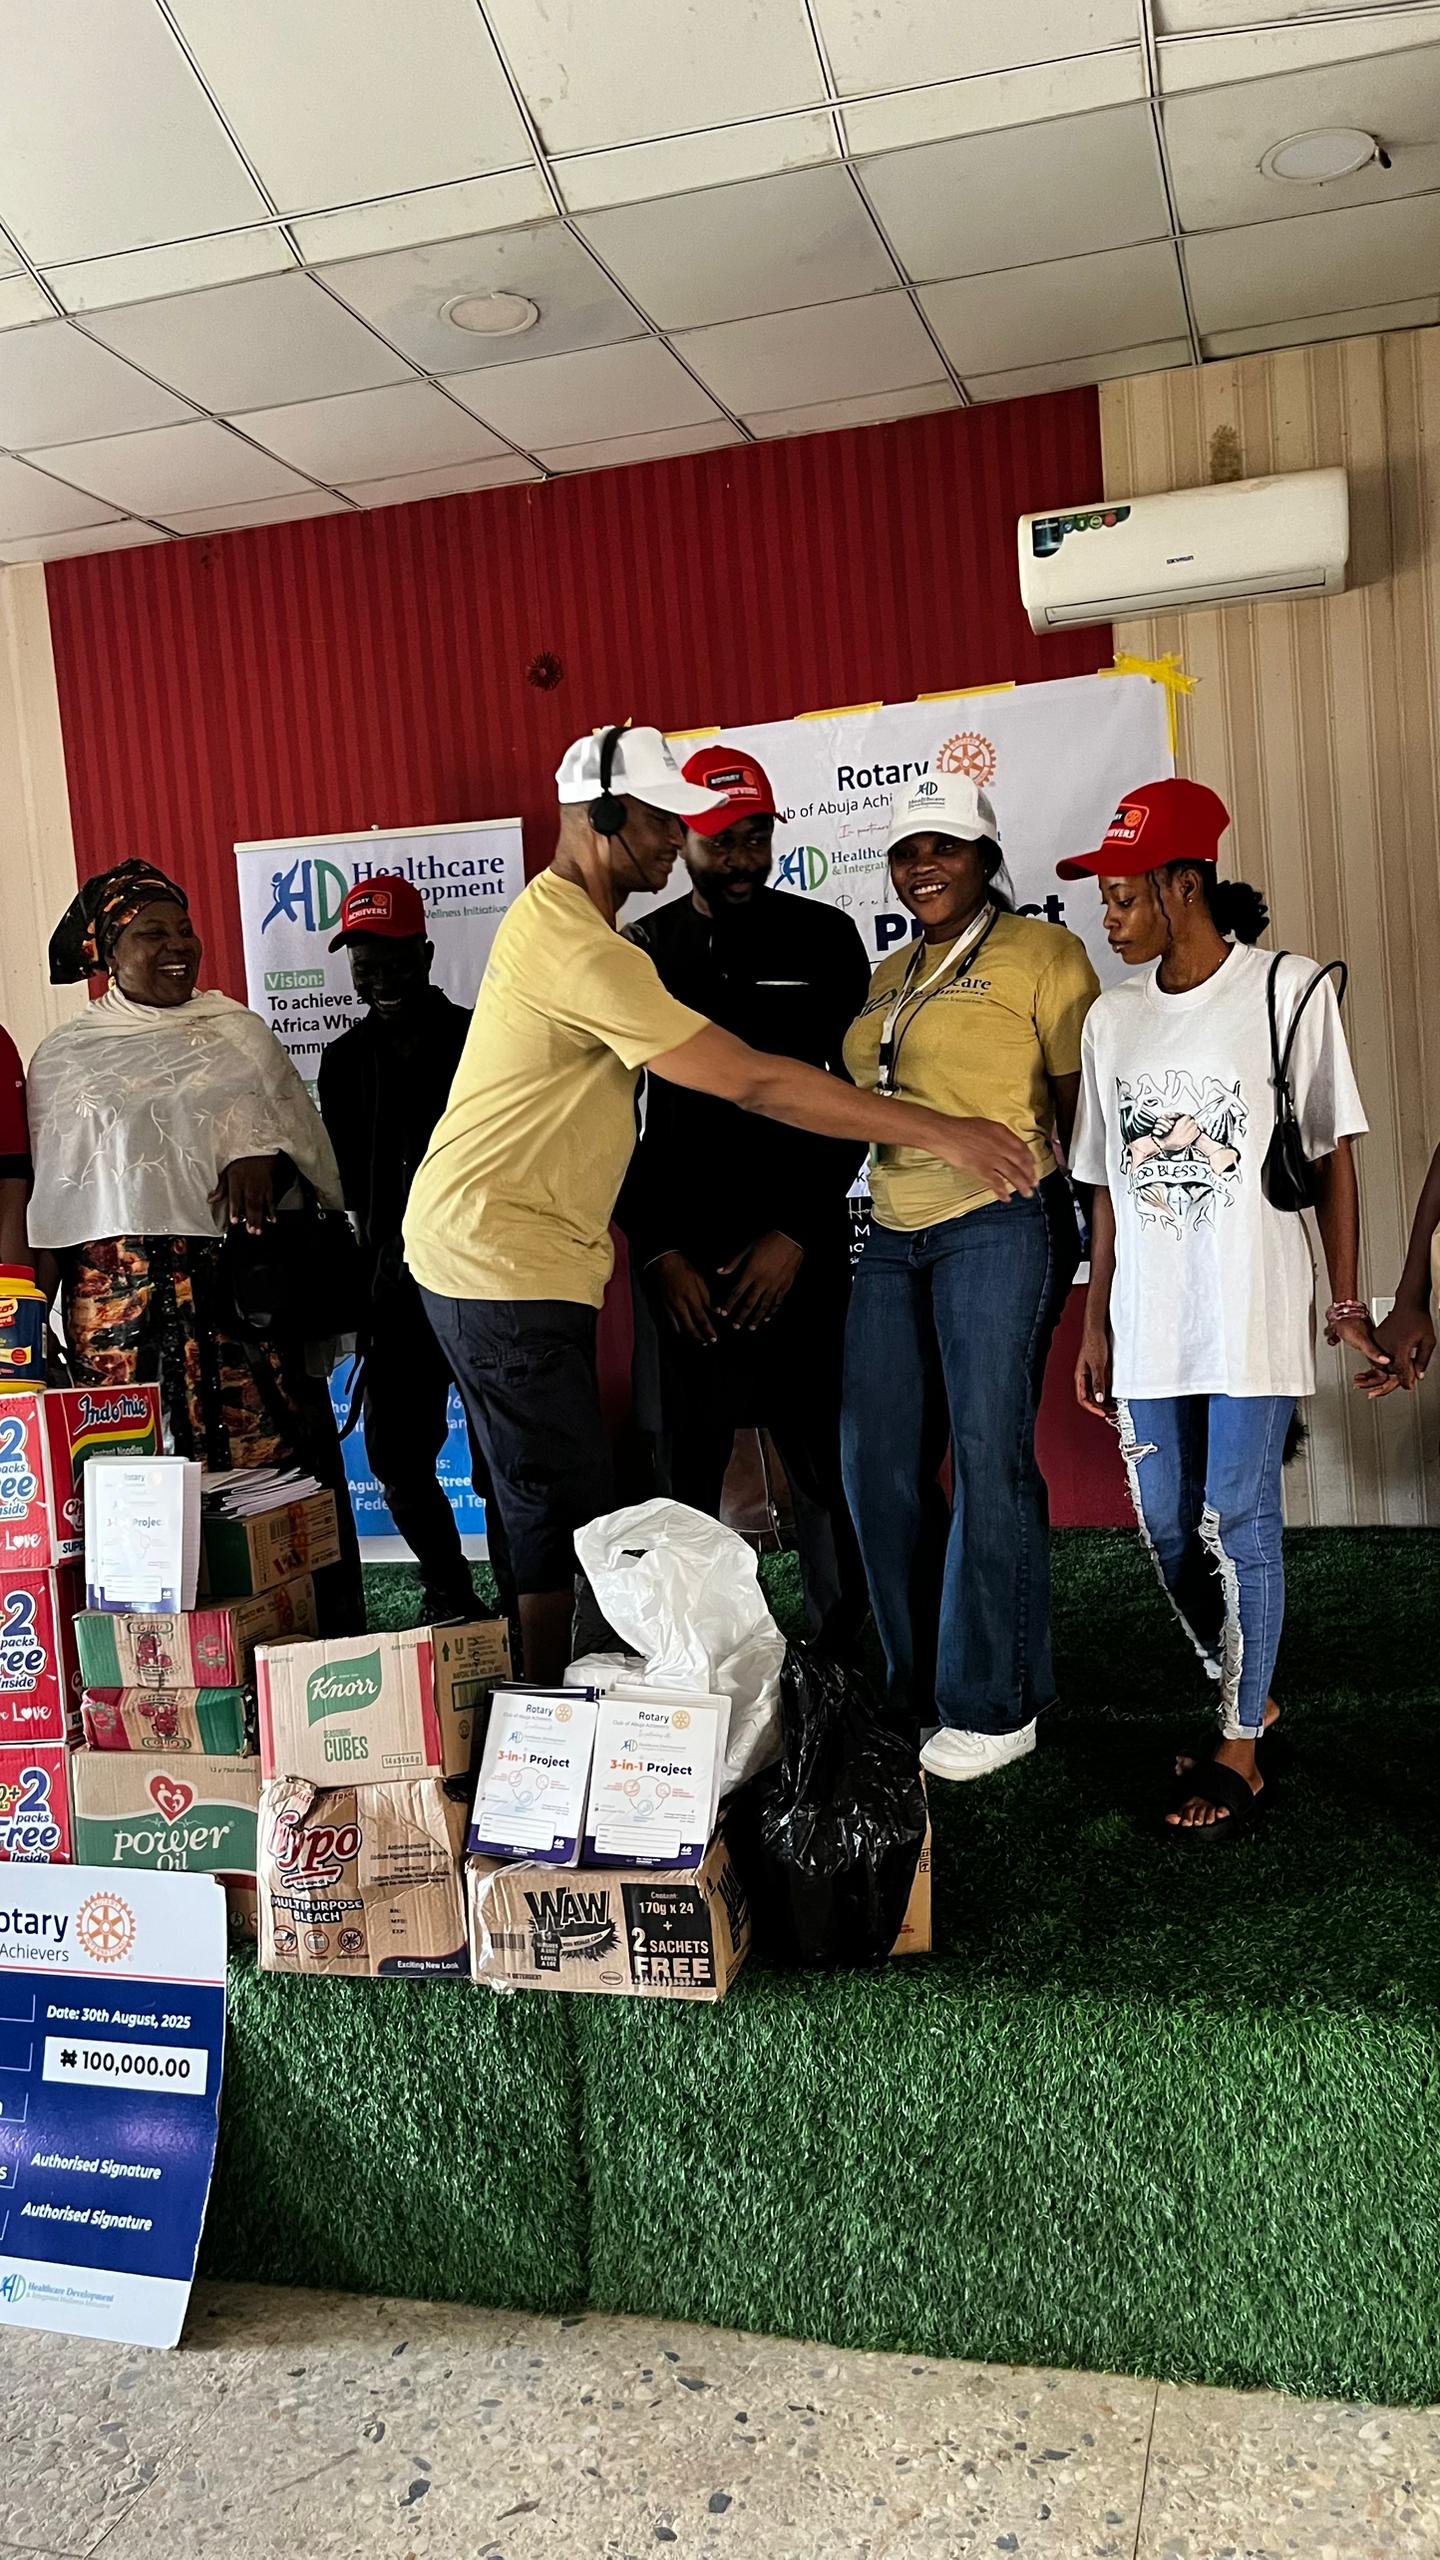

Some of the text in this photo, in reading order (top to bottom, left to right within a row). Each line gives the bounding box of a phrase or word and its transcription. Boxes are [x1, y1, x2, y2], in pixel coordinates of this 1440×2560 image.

[837, 761, 929, 791] Rotary
[800, 803, 814, 817] of
[818, 799, 859, 816] Abuja
[352, 855, 505, 885] Healthcare
[832, 867, 842, 876] &
[419, 878, 505, 905] opment
[267, 971, 324, 990] Vision:
[268, 995, 288, 1011] To
[292, 994, 352, 1010] achieve
[272, 1016, 320, 1033] Africa
[73, 1394, 148, 1435] Indomie
[62, 1542, 86, 1554] SUPE
[3, 1593, 32, 1637] 2
[309, 1675, 378, 1701] Knorr
[525, 1704, 553, 1716] Rotary
[639, 1711, 670, 1724] Rotary
[324, 1736, 369, 1762] CUBES
[498, 1750, 570, 1768] 3-in-1 Project
[610, 1758, 693, 1776] 3-in-1 Project
[16, 1813, 50, 1823] packs
[157, 1852, 189, 1871] Oil
[271, 1895, 363, 1910] MULTIPURPOSE
[523, 1887, 610, 1931] WAW
[639, 1902, 694, 1915] 170g x 24
[293, 1911, 340, 1922] BLEACH
[663, 1920, 673, 1931] +
[0, 1911, 69, 1943] otary
[631, 1927, 709, 1954] 2 SACHETS
[0, 1944, 70, 1962] Achievers
[397, 1960, 459, 1970] Exciting New Look
[634, 1956, 711, 1980] FREE
[47, 2005, 191, 2029] Date: 30th August, 2025
[82, 2050, 191, 2078] 100,000.00
[31, 2152, 162, 2180] Authorised Signature
[21, 2202, 152, 2231] Authorised Signature
[28, 2282, 114, 2302] Healthcare Development
